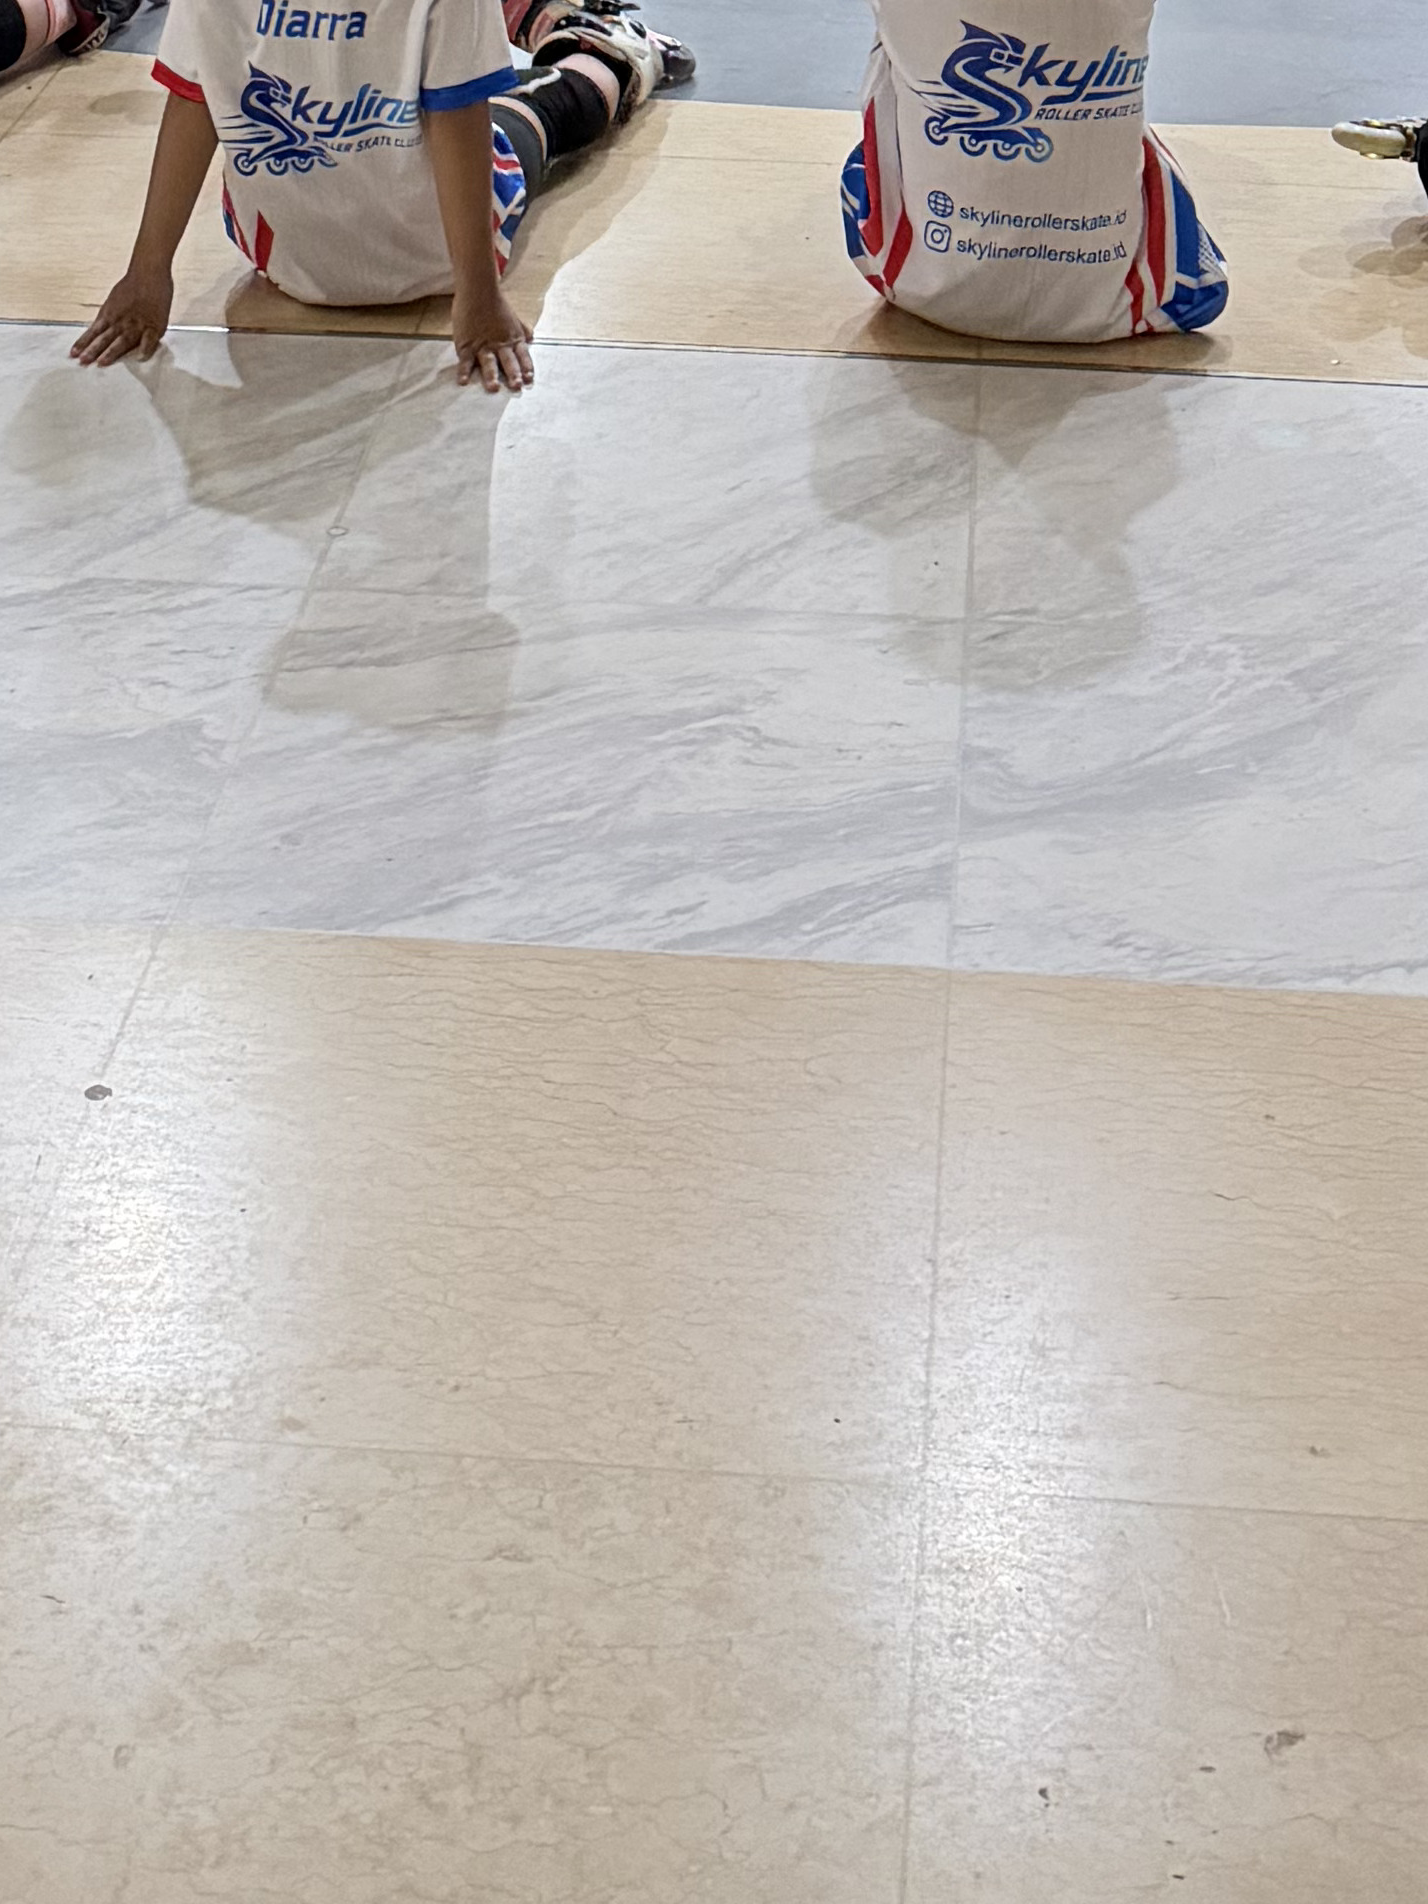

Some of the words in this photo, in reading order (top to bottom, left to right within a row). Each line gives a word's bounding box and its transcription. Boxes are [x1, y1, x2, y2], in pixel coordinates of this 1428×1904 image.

[1034, 107, 1092, 120] ROLLER
[959, 205, 1127, 232] skylinerollerskate.id
[956, 237, 1128, 265] skylinerollerskate.id
